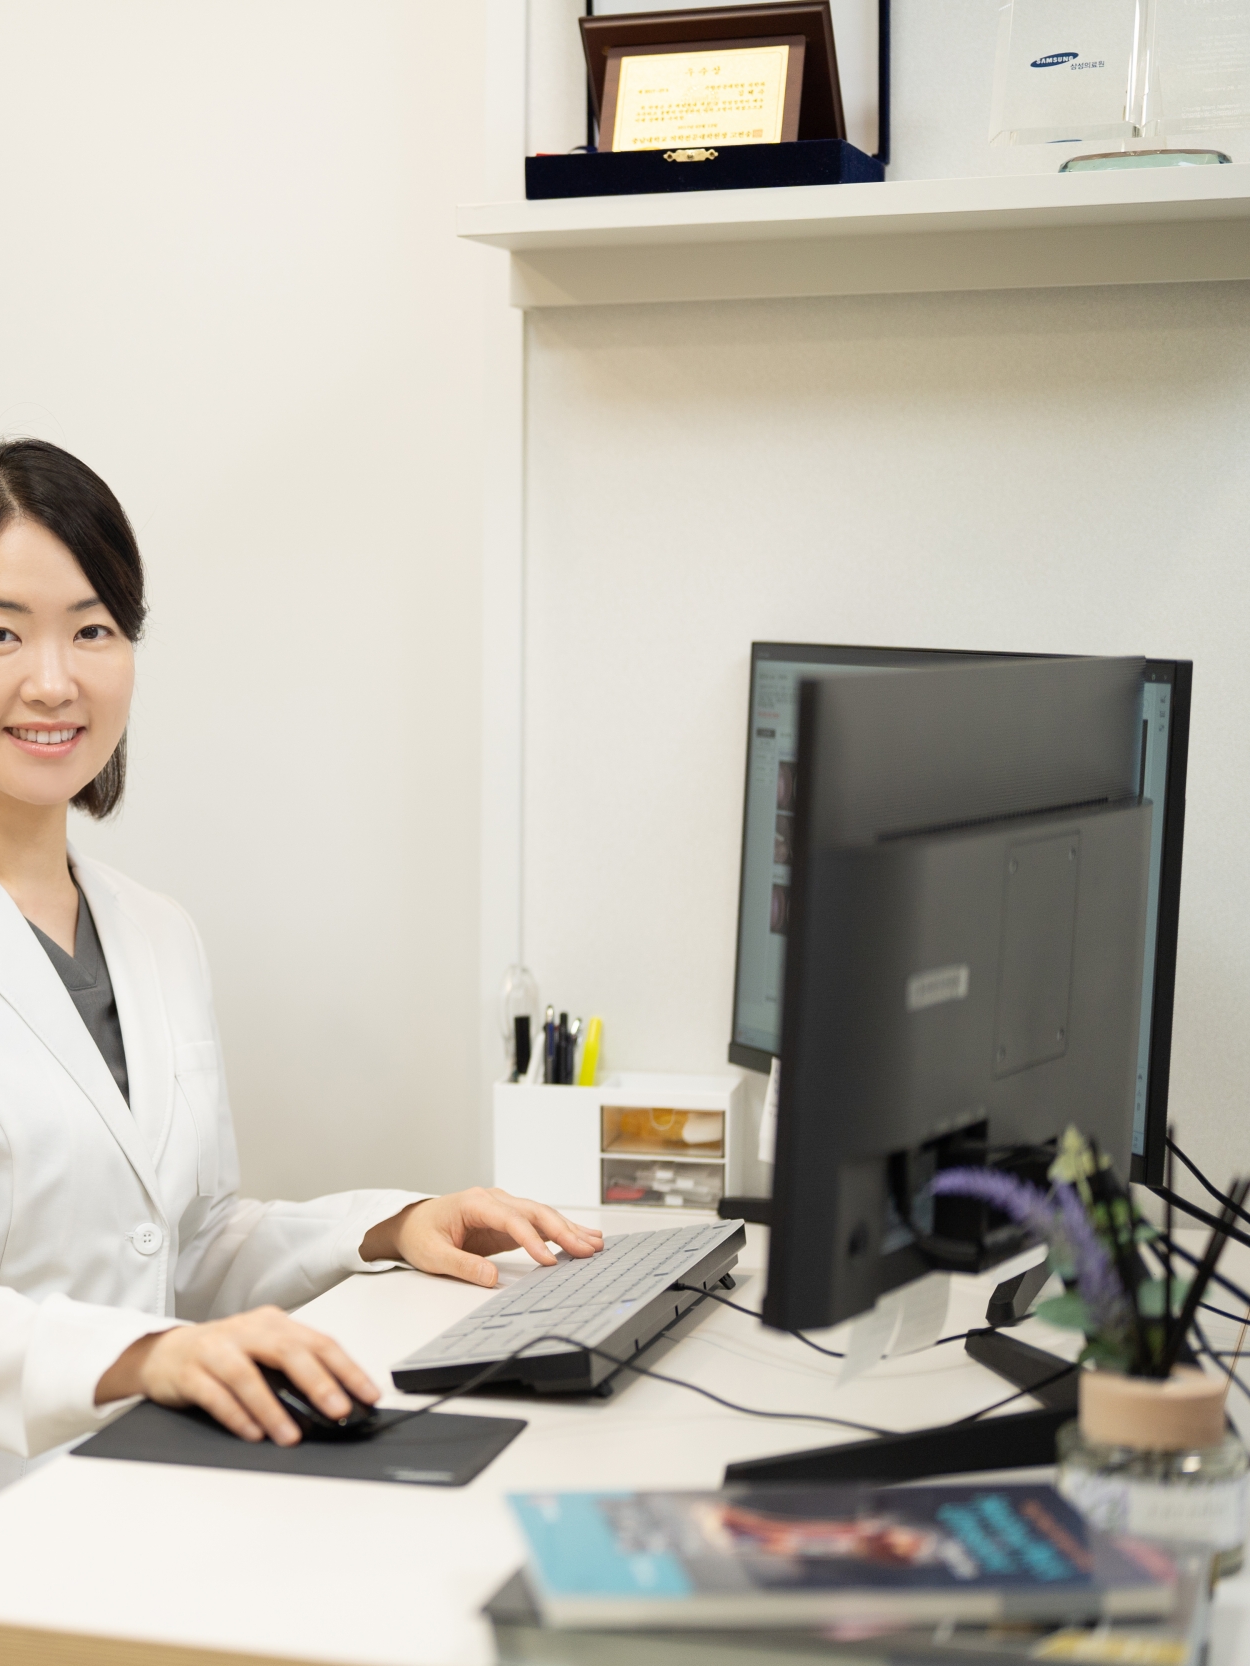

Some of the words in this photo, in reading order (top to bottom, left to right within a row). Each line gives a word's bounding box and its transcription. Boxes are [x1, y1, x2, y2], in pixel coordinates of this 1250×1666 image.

[1035, 55, 1074, 65] SAMSUNG
[1070, 60, 1105, 71] 삼성의료원
[632, 135, 667, 144] 충남대학교
